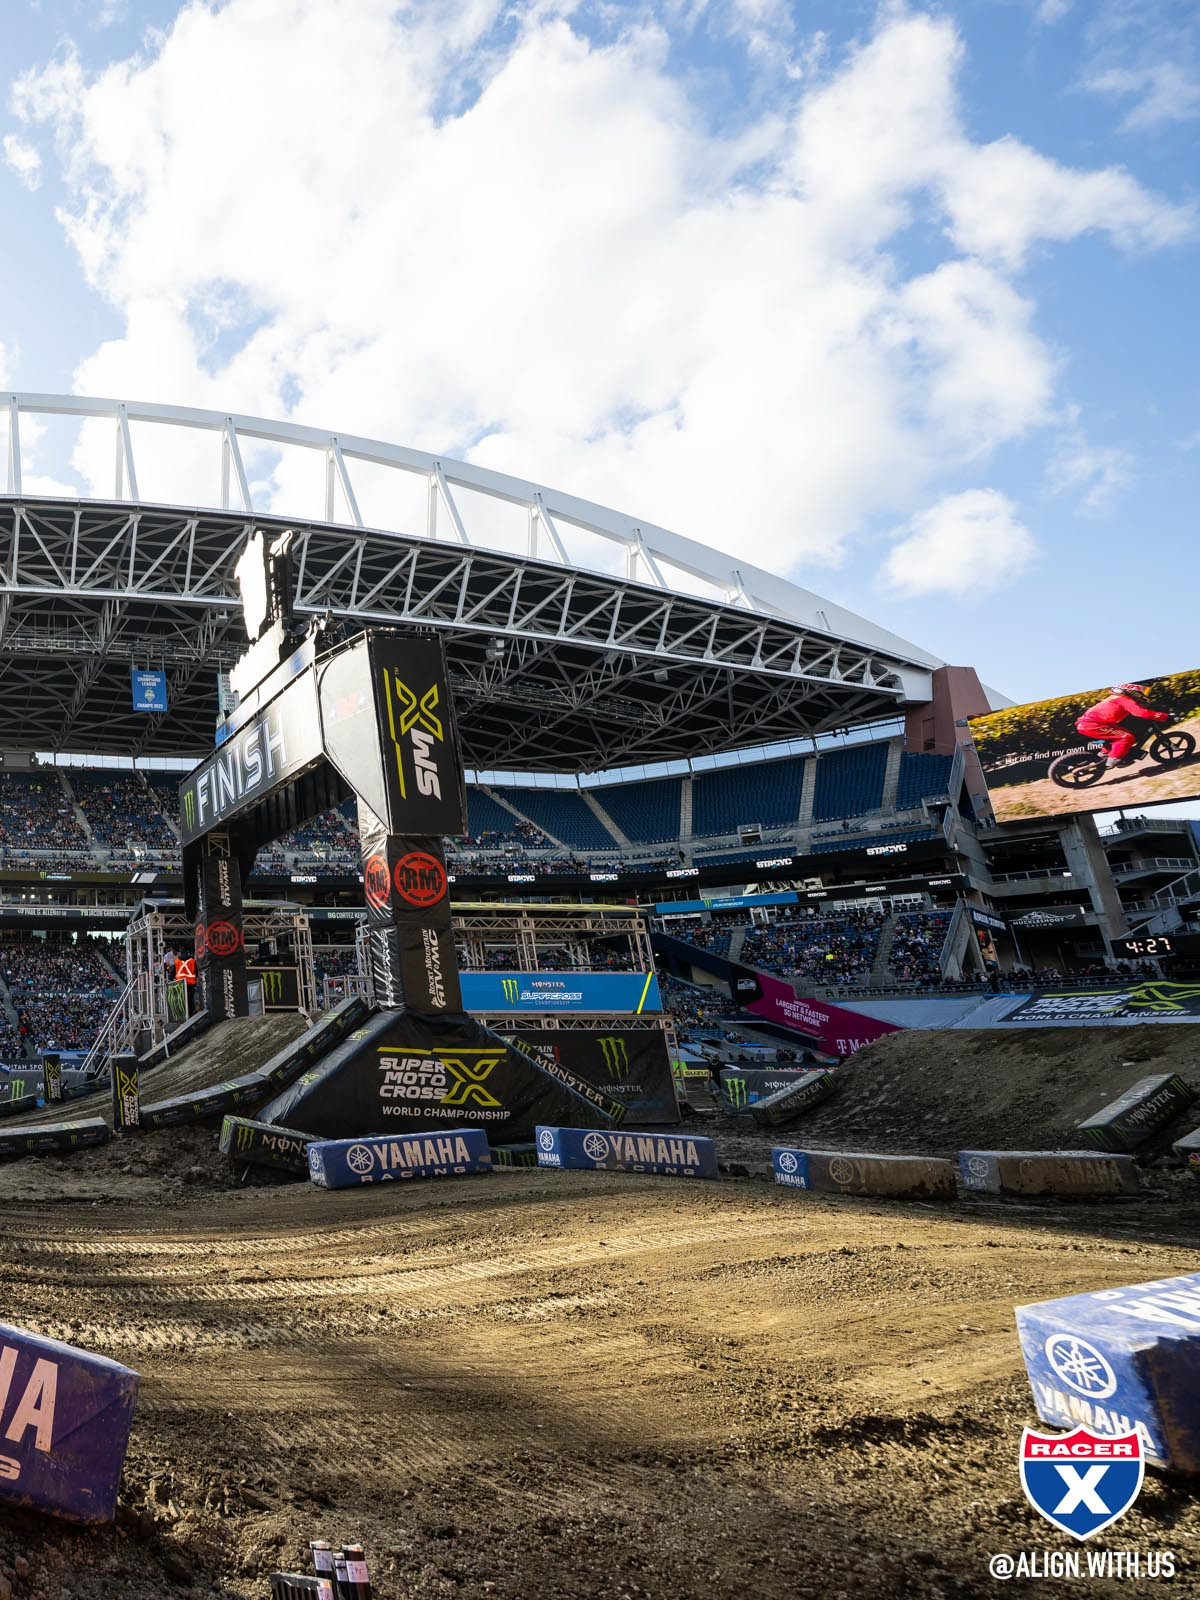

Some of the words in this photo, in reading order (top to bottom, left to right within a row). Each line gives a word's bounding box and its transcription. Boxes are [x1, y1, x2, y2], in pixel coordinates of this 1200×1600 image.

[395, 677, 443, 800] SMX
[1034, 751, 1049, 760] find
[1052, 749, 1064, 758] my
[1066, 746, 1085, 754] own
[197, 704, 287, 827] FINISH
[866, 843, 908, 857] STACYC
[756, 858, 793, 869] STACYC
[508, 875, 535, 883] STACYC
[590, 874, 618, 882] STACYC
[666, 868, 699, 879] STACYC
[1013, 917, 1065, 926] MUCKLESHOOT
[422, 929, 434, 968] MOUNTAIN
[1125, 937, 1171, 953] 4:27
[428, 968, 437, 995] ROCKY
[520, 992, 582, 1000] SUPERCROSS
[776, 998, 800, 1012] LARGEST
[805, 1008, 829, 1022] FASTEST
[783, 1008, 791, 1017] 5G
[792, 1010, 820, 1027] NETWORK
[1012, 1013, 1065, 1021] WORLD
[379, 1057, 446, 1074] SUPER
[383, 1072, 446, 1087] MOTO
[534, 1055, 604, 1106] MONSTER
[379, 1085, 449, 1099] CROSS
[781, 1081, 823, 1109] MONSTER
[123, 1094, 131, 1125] SUPER
[382, 1106, 421, 1117] WORLD
[424, 1108, 511, 1120] CHAMPIONSHIP
[1126, 1088, 1175, 1126] MONSTER
[372, 1136, 471, 1170] YAMAHA
[538, 1152, 560, 1162] YAMAHA
[609, 1135, 700, 1166] YAMAHA
[361, 1166, 466, 1182] RACING
[596, 1162, 695, 1175] RACING
[776, 1173, 805, 1185] YAMAHA
[1037, 1382, 1155, 1449] YAMAHA
